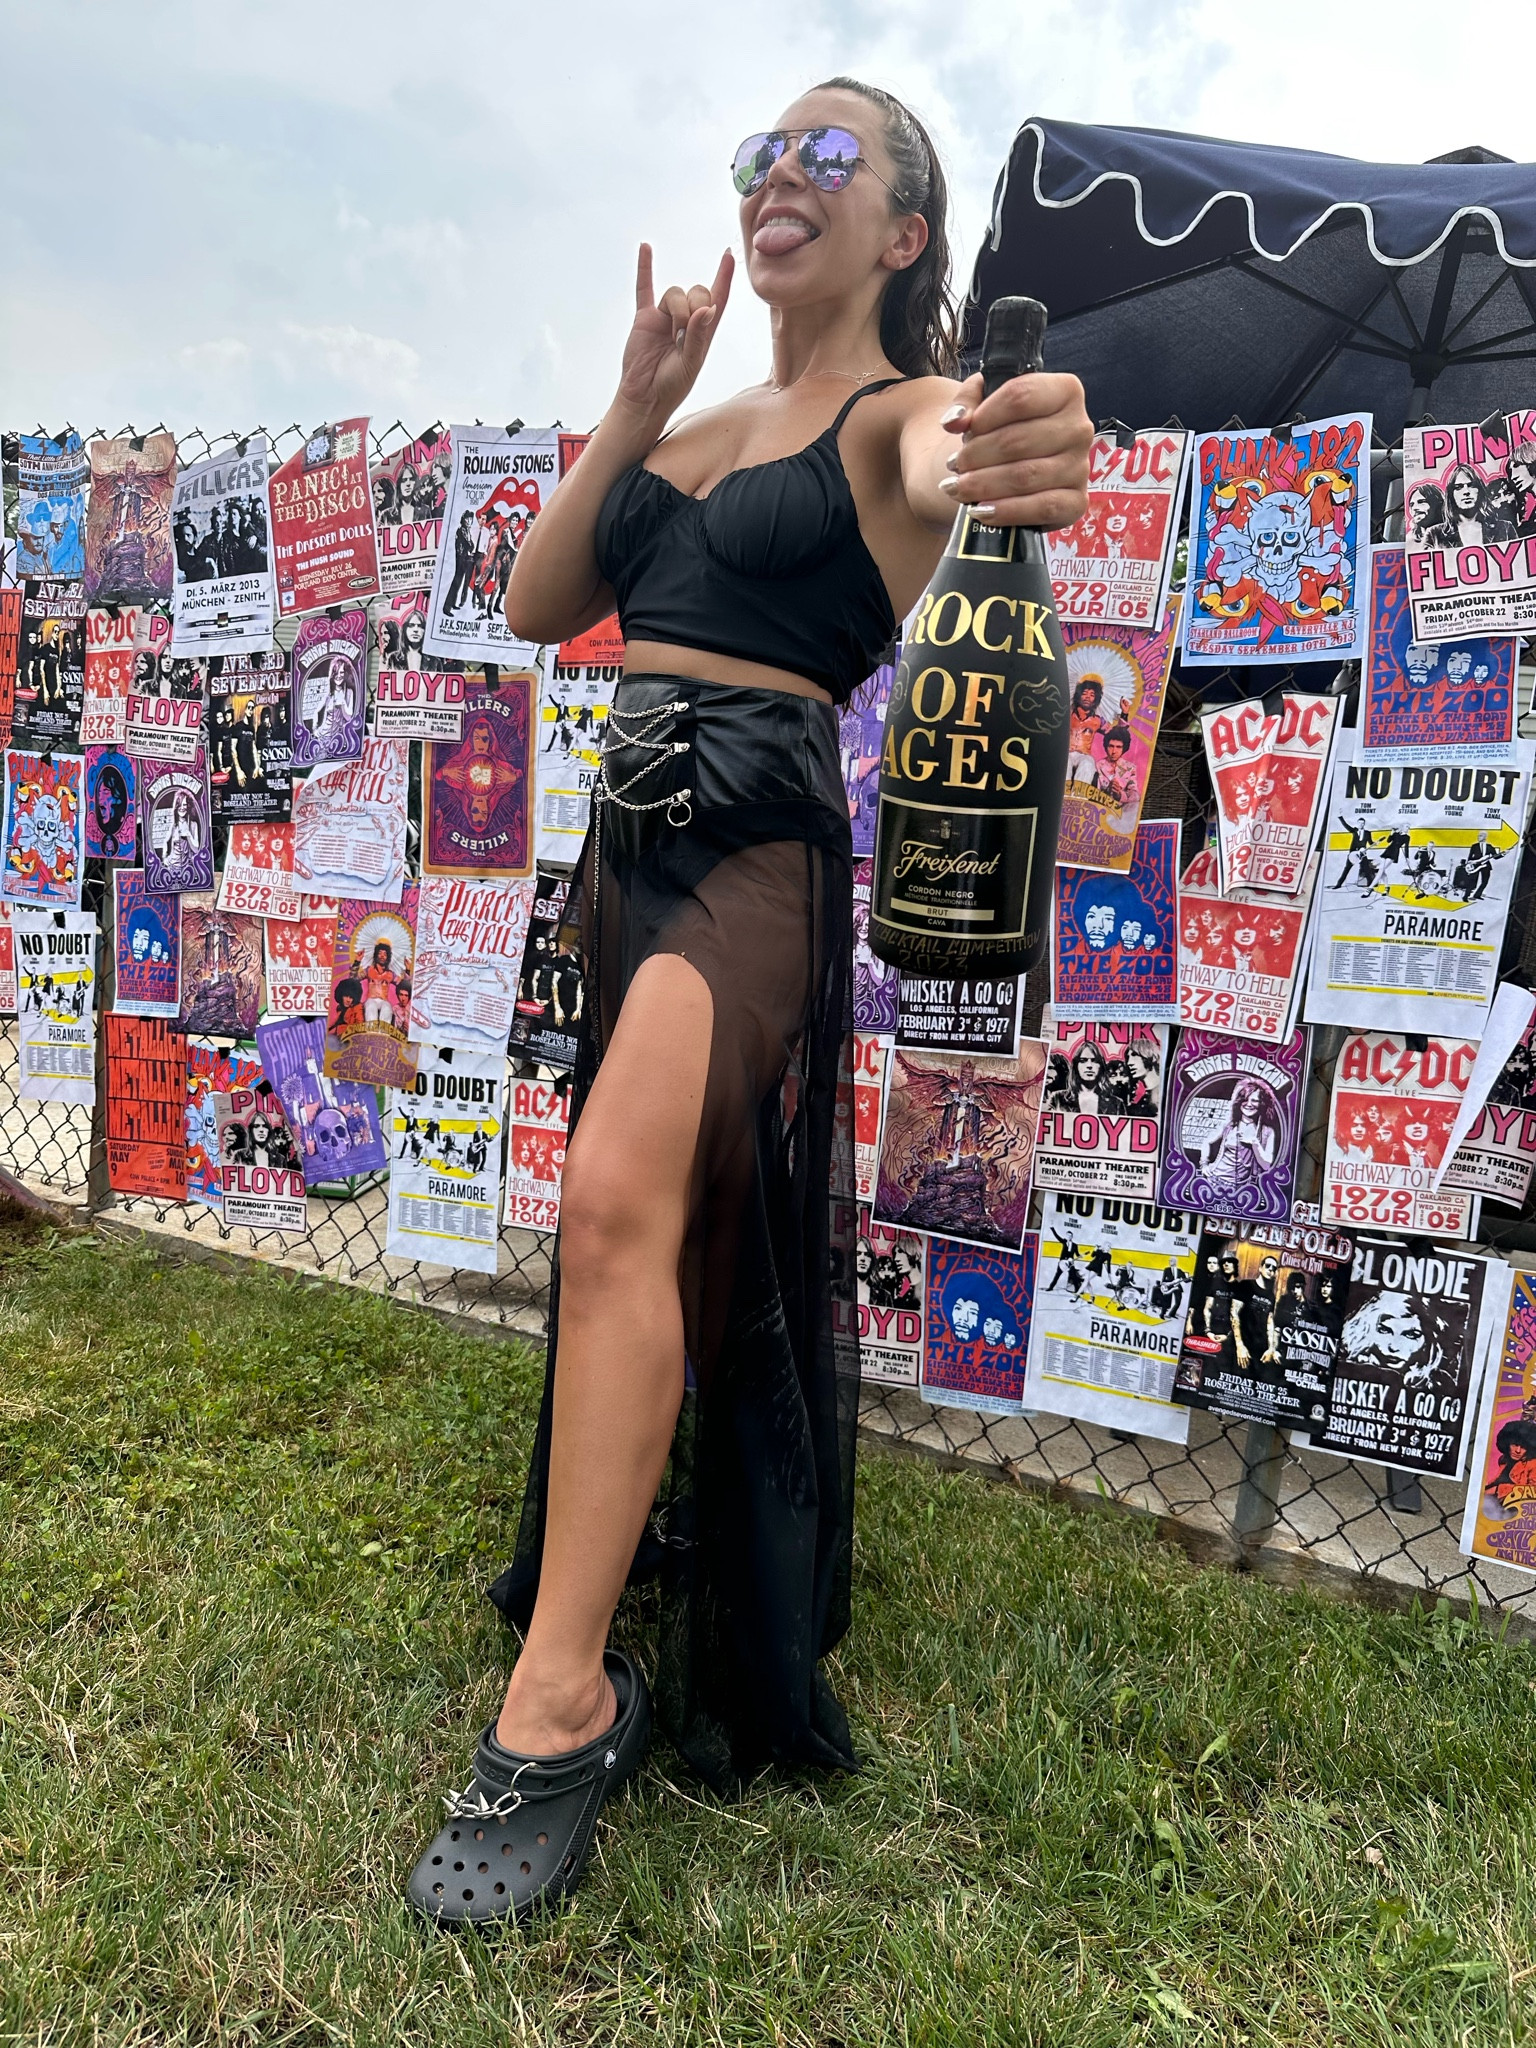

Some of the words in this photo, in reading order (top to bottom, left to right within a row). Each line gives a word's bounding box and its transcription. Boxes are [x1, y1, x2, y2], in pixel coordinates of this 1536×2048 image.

[465, 446, 479, 454] THE
[1421, 411, 1536, 469] PINK
[463, 456, 510, 474] ROLLING
[512, 454, 555, 473] STONES
[177, 458, 265, 505] KILLERS
[1101, 483, 1120, 491] LIVE
[275, 503, 305, 522] THE
[304, 486, 367, 524] DISCO
[465, 490, 485, 500] TOUR
[276, 545, 293, 559] THE
[296, 531, 337, 555] DRESDEN
[340, 524, 372, 540] DOLLS
[211, 580, 236, 595] MÄRZ
[239, 579, 261, 591] 2013
[1118, 601, 1148, 619] 05
[1425, 611, 1458, 624] FRIDAY,
[1458, 608, 1496, 620] OCTOBER
[1495, 607, 1506, 617] 22
[456, 621, 481, 632] STADIUM
[487, 622, 503, 633] SEPT
[907, 591, 1056, 661] ROCK
[1189, 641, 1235, 654] TUESDAY
[1237, 643, 1298, 655] SEPTEMBER
[1300, 639, 1327, 651] 10TH
[1330, 634, 1354, 646] 2013
[211, 670, 292, 695] SEVENFOLD
[377, 670, 466, 703] FLOYD
[911, 666, 1006, 727] OF
[1370, 690, 1435, 715] THE
[1441, 688, 1510, 713] ZOO
[126, 694, 202, 728] FLOYD
[380, 710, 420, 719] PARAMOUNT
[423, 711, 459, 721] THEATRE
[1370, 714, 1420, 725] LIGHTS
[1422, 714, 1438, 723] BY
[1442, 713, 1470, 722] THE
[1473, 712, 1507, 721] ROAD
[83, 715, 116, 729] 1979
[430, 725, 457, 734] 8:30p.m.
[83, 728, 116, 740] TOUR
[129, 730, 168, 742] PARAMOUNT
[169, 734, 195, 745] THEATRE
[880, 724, 1030, 792] AGES
[1345, 766, 1391, 800] NO
[1399, 767, 1520, 805] DOUBT
[450, 832, 509, 849] KILLERS
[1267, 826, 1305, 847] HELL
[893, 840, 1002, 881] Freixenet
[1258, 847, 1289, 857] OAKLAND
[1291, 850, 1300, 858] CA
[1263, 866, 1294, 884] 05
[226, 882, 272, 900] 1979
[908, 884, 941, 896] CORDON
[944, 890, 975, 899] NEGRO
[1229, 895, 1249, 904] LIVE
[225, 894, 269, 912] TOUR
[279, 902, 297, 915] 05
[926, 907, 948, 917] BRUT
[927, 918, 947, 927] CAVA
[1383, 914, 1484, 942] PARAMORE
[20, 932, 44, 955] NO
[49, 932, 92, 955] DOUBT
[468, 921, 518, 958] VEIL
[944, 928, 1041, 957] COMPETITION
[1058, 956, 1110, 975] THE
[1118, 956, 1173, 975] ZOO
[271, 985, 315, 1000] 1979
[900, 979, 956, 1004] WHISKEY
[960, 982, 973, 1003] A
[975, 980, 993, 1005] GO
[996, 982, 1014, 1006] GO
[273, 998, 315, 1011] TOUR
[910, 1004, 922, 1013] LOS
[924, 1005, 957, 1014] ANGELES,
[959, 1005, 999, 1015] CALIFORNIA
[1245, 1015, 1277, 1034] 05
[48, 1027, 86, 1043] PARAMORE
[904, 1031, 927, 1040] DIRECT
[929, 1032, 949, 1041] FROM
[951, 1033, 966, 1042] NEW
[967, 1034, 986, 1043] YORK
[987, 1034, 1003, 1043] CITY
[433, 1073, 497, 1104] DOUBT
[1394, 1088, 1417, 1097] LIVE
[1037, 1112, 1158, 1154] FLOYD
[109, 1142, 140, 1153] SATURDAY
[110, 1151, 130, 1163] MAY
[1039, 1156, 1101, 1171] PARAMOUNT
[1104, 1162, 1149, 1175] THEATRE
[1041, 1167, 1067, 1177] FRIDAY,
[1067, 1171, 1098, 1180] OCTOBER
[1329, 1160, 1396, 1184] HIGHWAY
[1401, 1167, 1424, 1187] TO
[1486, 1156, 1530, 1176] THEATRE
[222, 1166, 306, 1198] FLOYD
[429, 1179, 487, 1202] PARAMORE
[508, 1176, 548, 1197] HIGHWAY
[1494, 1175, 1525, 1191] 8:30p.m.
[509, 1195, 559, 1213] 1979
[1331, 1184, 1412, 1208] 1979
[1418, 1193, 1453, 1204] OAKLAND
[1455, 1196, 1465, 1204] CA
[228, 1199, 272, 1211] PARAMOUNT
[273, 1203, 302, 1214] THEATRE
[1056, 1193, 1095, 1217] NO
[1103, 1199, 1203, 1235] DOUBT
[1214, 1204, 1233, 1214] 1969
[508, 1208, 559, 1228] TOUR
[1427, 1211, 1461, 1230] 05
[1205, 1210, 1351, 1264] SEVENFOLD
[1351, 1247, 1476, 1300] BLONDIE
[1090, 1321, 1179, 1356] PARAMORE
[1281, 1326, 1339, 1354] SAOSIN
[874, 1350, 914, 1363] THEATRE
[928, 1341, 979, 1364] THE
[1204, 1377, 1254, 1397] ROSELAND
[1256, 1388, 1300, 1408] THEATER
[1219, 1371, 1254, 1387] FRIDAY
[1255, 1381, 1276, 1393] NOV
[1278, 1386, 1288, 1396] 25
[1207, 1405, 1276, 1427] avengedsevenfold.com
[1331, 1404, 1347, 1414] LOS
[1350, 1407, 1390, 1423] ANGELES,
[1393, 1414, 1441, 1431] CALIFORNIA
[1354, 1437, 1377, 1450] FROM
[1380, 1442, 1398, 1453] NEW
[1401, 1446, 1423, 1458] YORK
[1425, 1450, 1443, 1462] CITY
